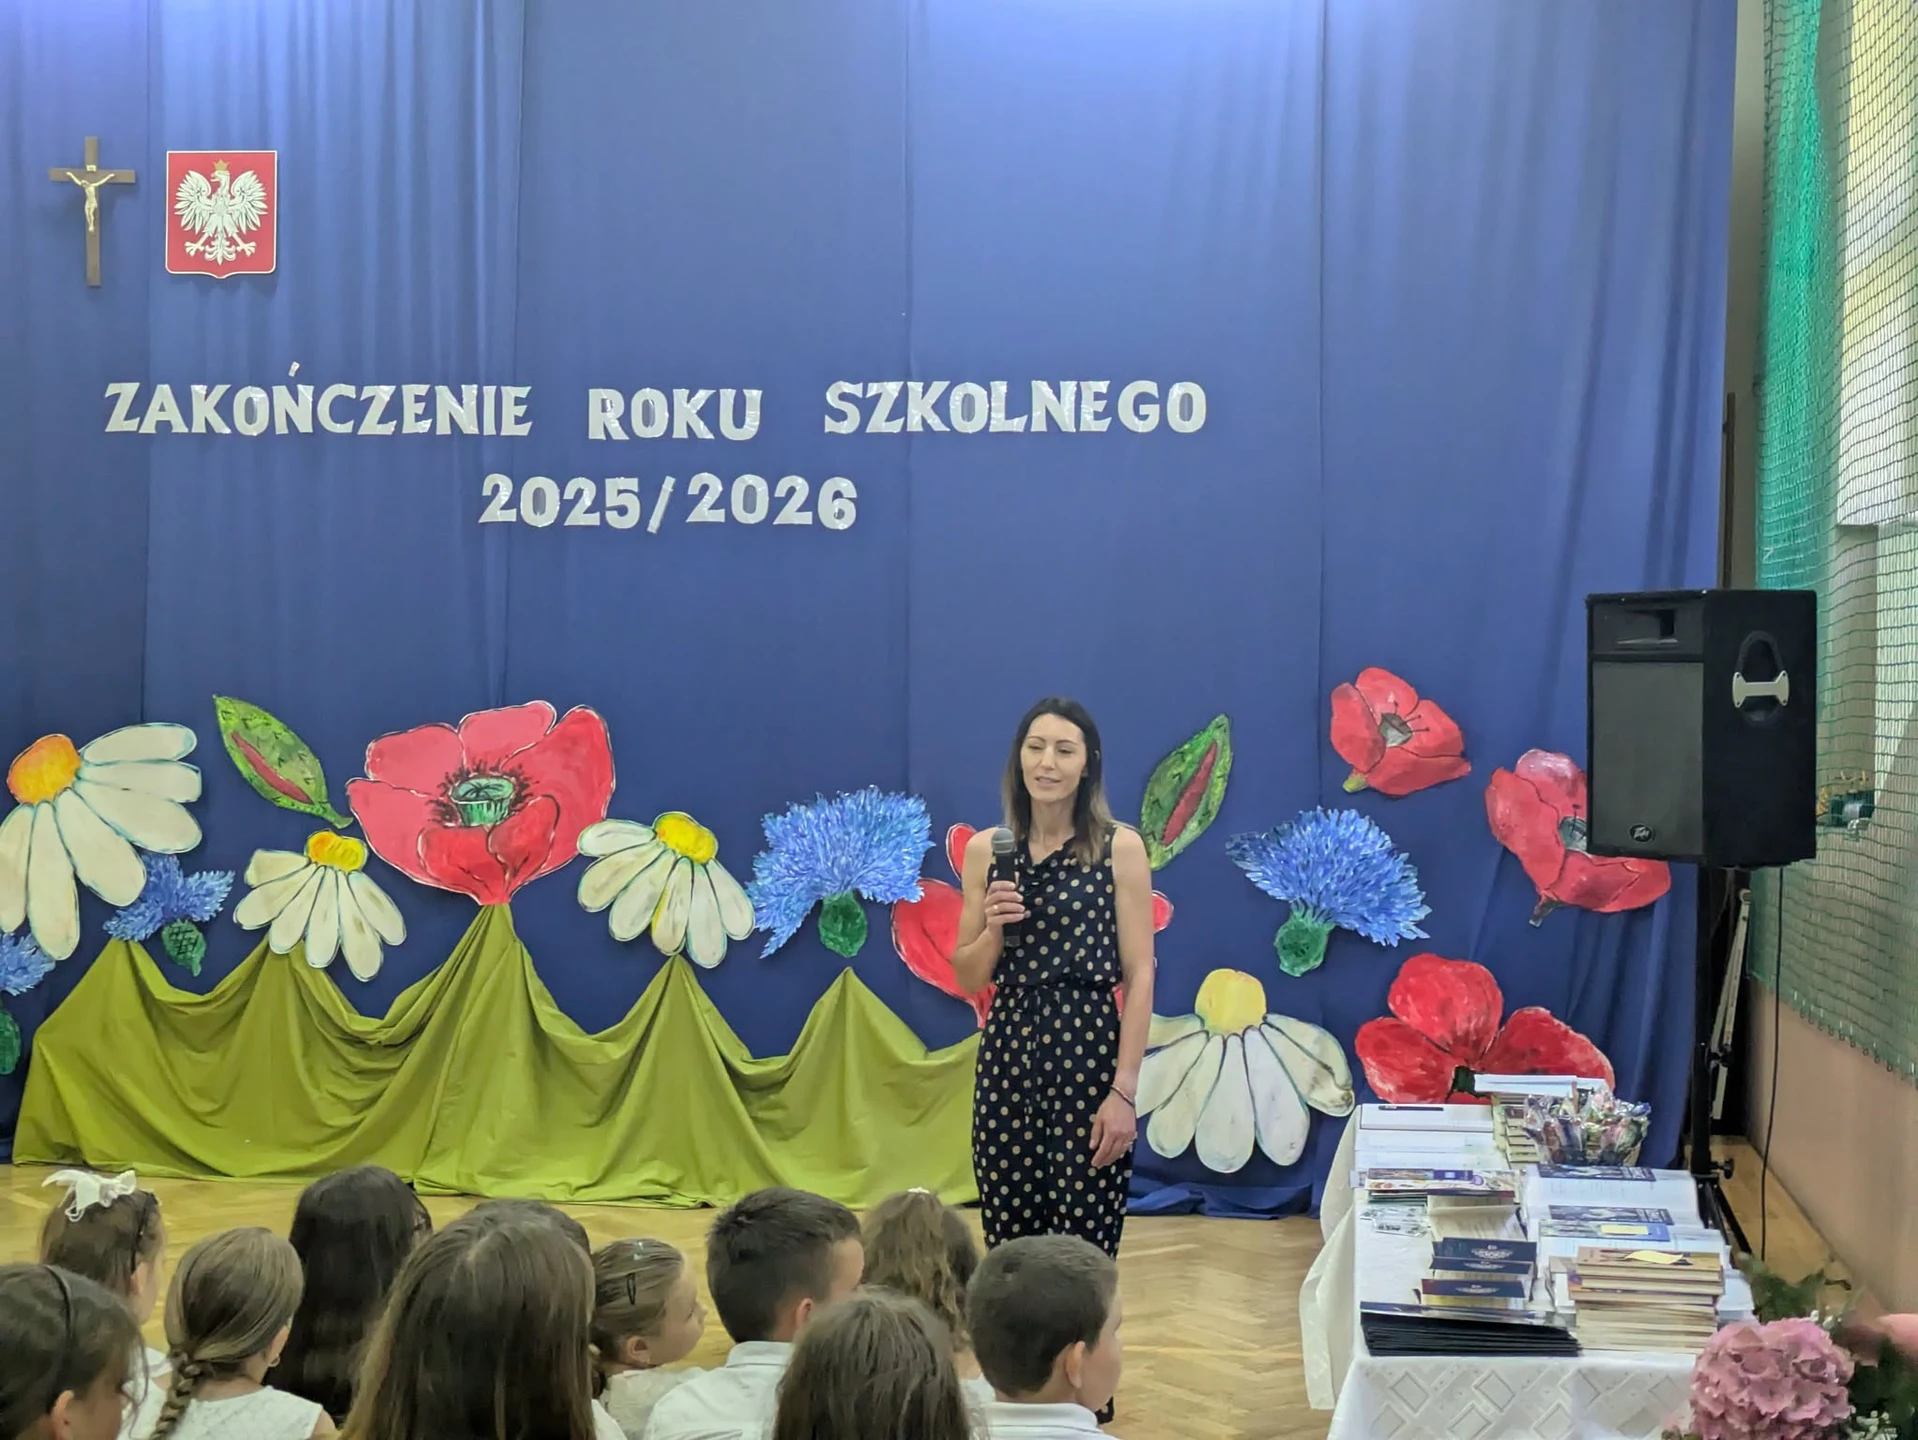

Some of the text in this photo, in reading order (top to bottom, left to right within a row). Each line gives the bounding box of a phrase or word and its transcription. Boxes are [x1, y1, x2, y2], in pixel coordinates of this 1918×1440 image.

[104, 361, 1208, 442] ZAKOŃCZENIE ROKU SZKOLNEGO
[478, 471, 858, 534] 2025/2026
